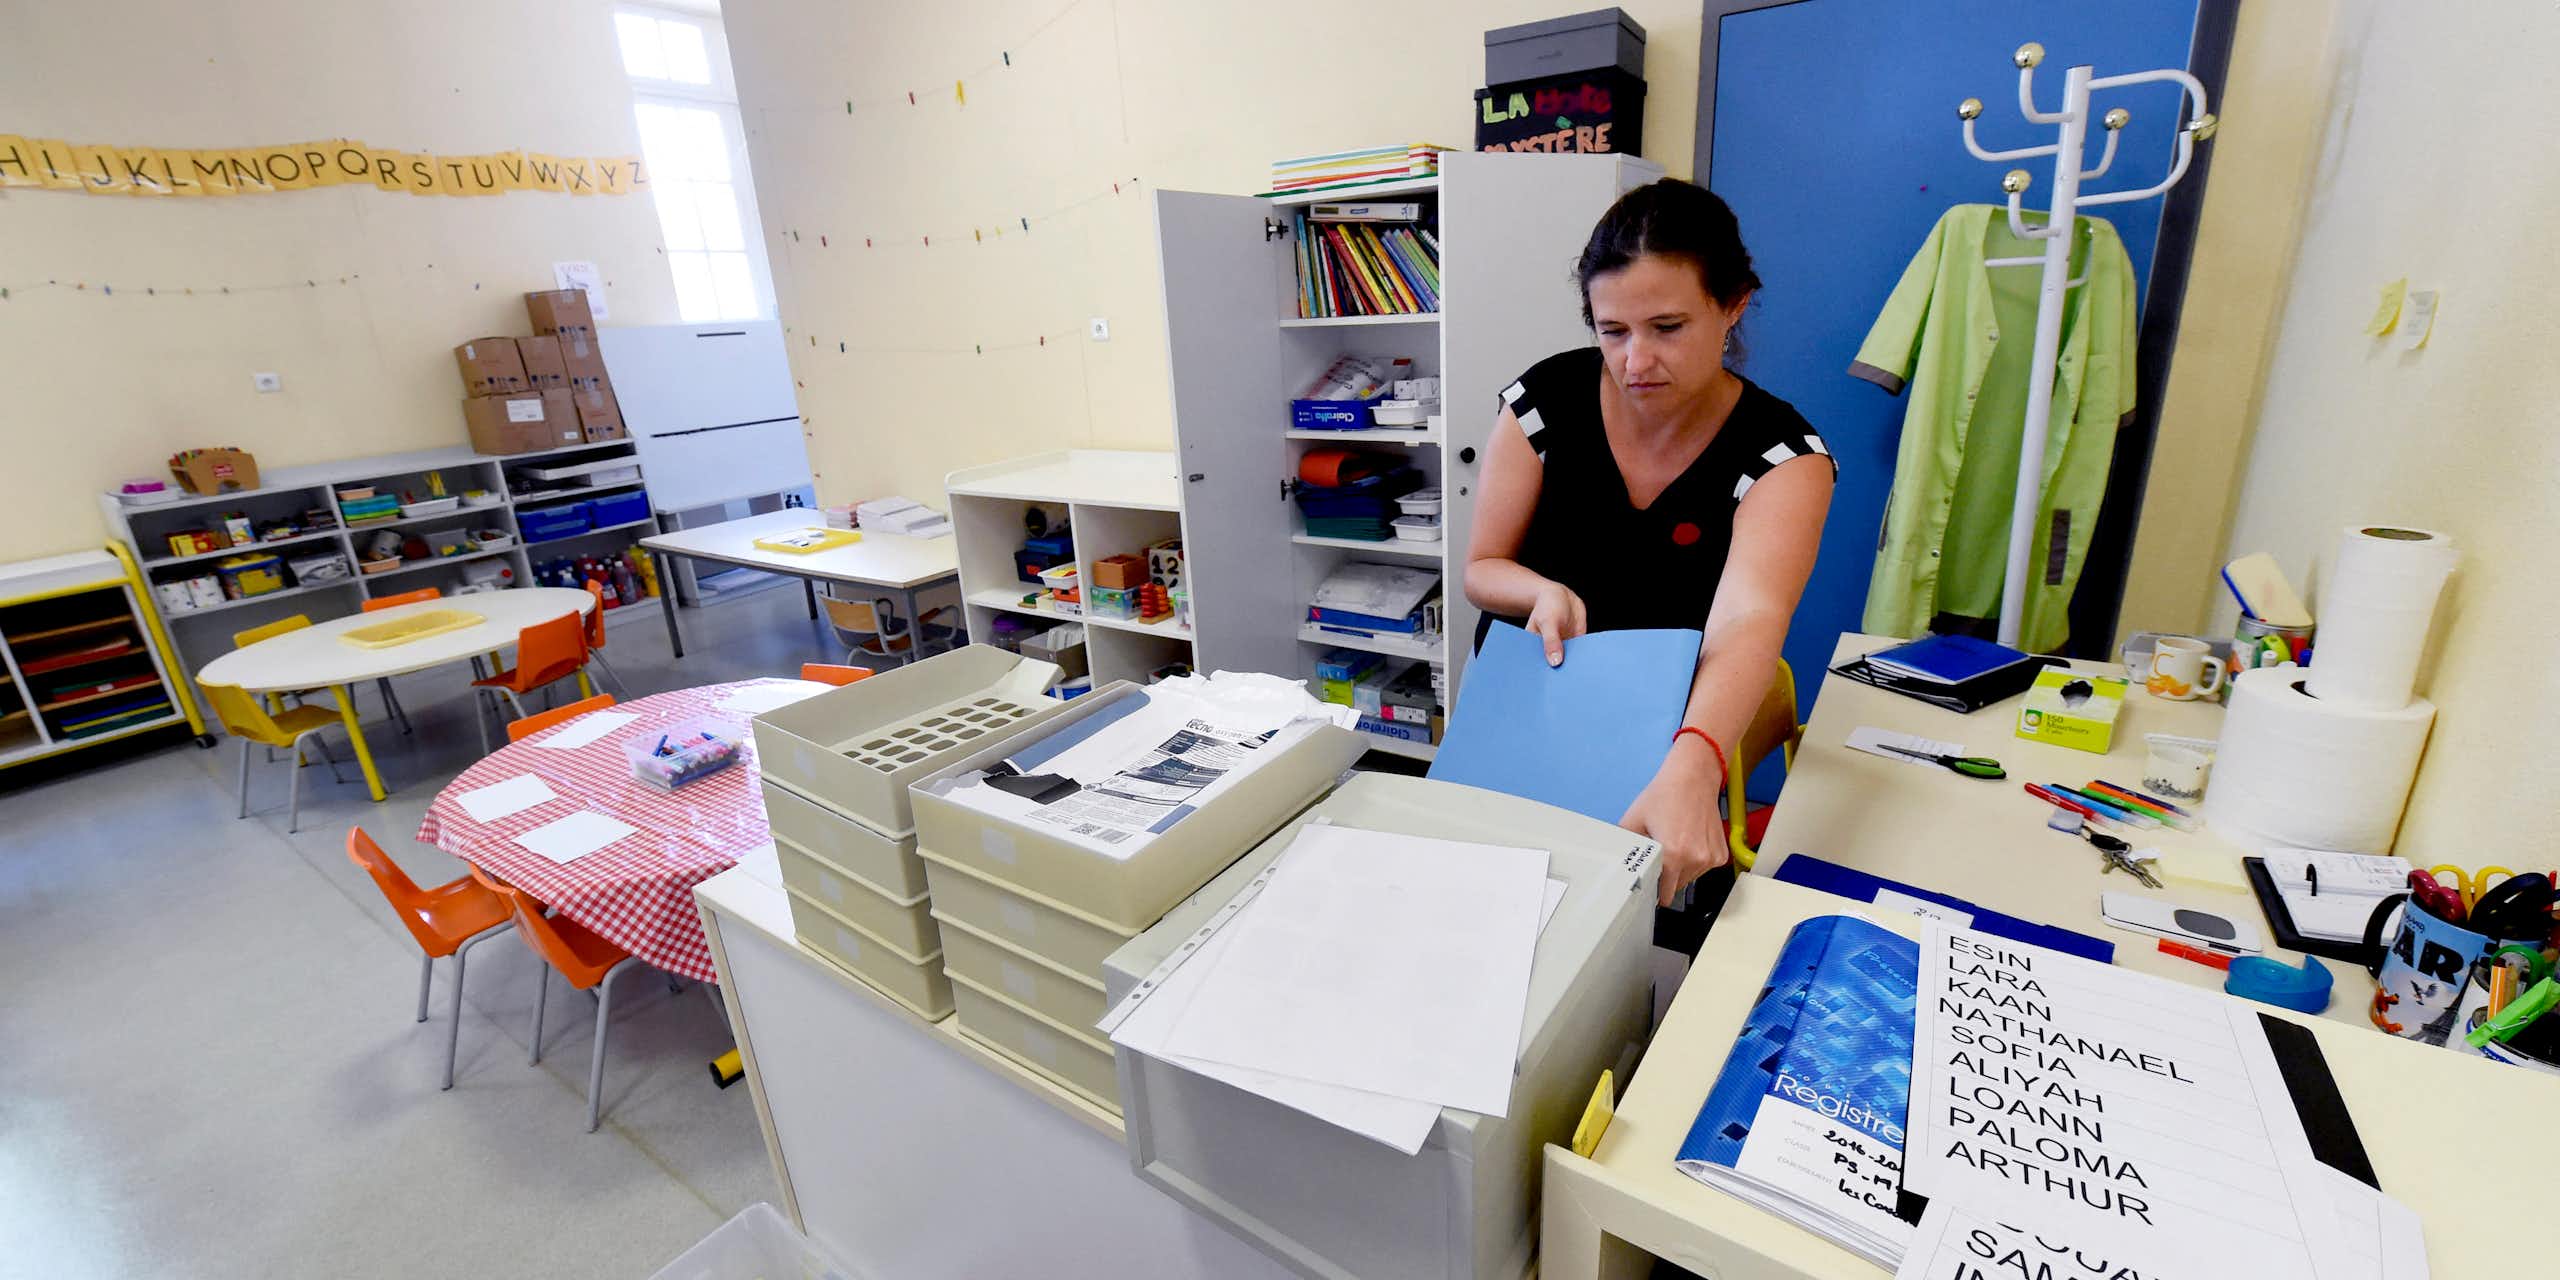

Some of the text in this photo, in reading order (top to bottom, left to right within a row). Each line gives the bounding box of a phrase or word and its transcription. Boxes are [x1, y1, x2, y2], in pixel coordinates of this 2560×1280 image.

[1483, 92, 1530, 124] LA
[1949, 935, 2031, 972] ESIN
[1949, 955, 2047, 998] LARA
[1948, 976, 2051, 1022] KAAN
[1939, 997, 2194, 1084] NATHANAEL
[1951, 1025, 2076, 1079] SOFIA
[1774, 1073, 1905, 1143] Registre
[1949, 1051, 2104, 1113] ALIYAH
[1950, 1076, 2103, 1143] LOANN
[1949, 1106, 2148, 1189] PALOMA
[1945, 1141, 2154, 1226] ARTHUR
